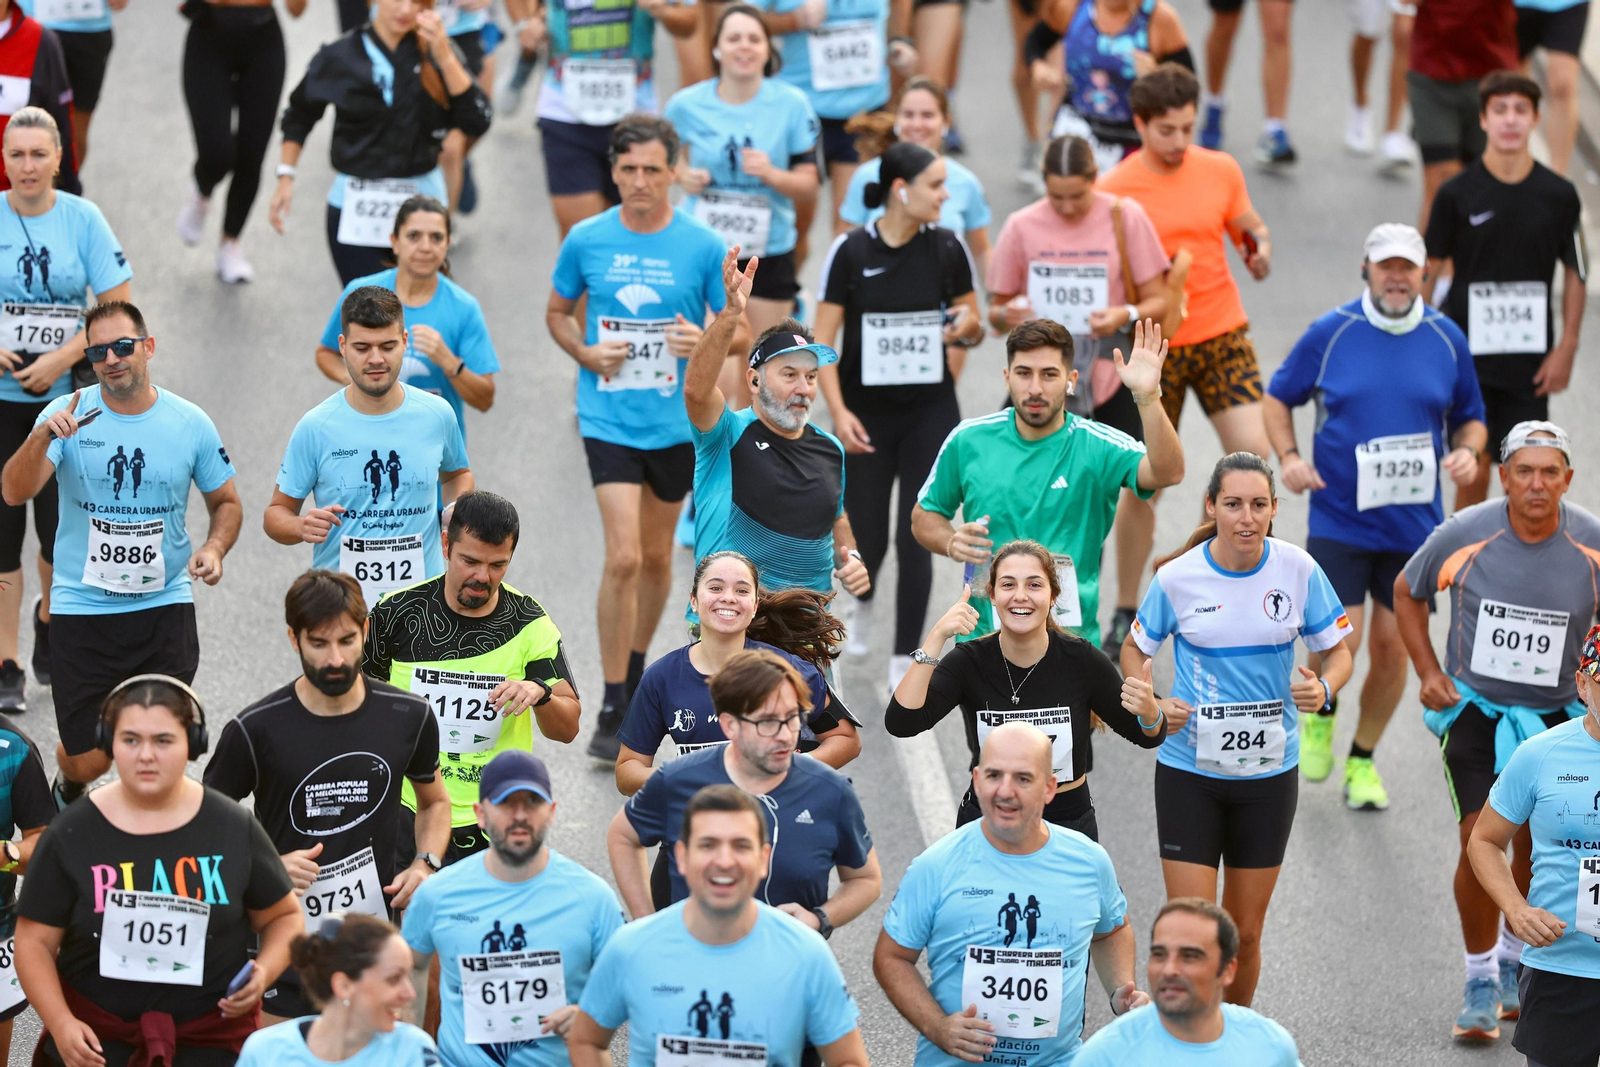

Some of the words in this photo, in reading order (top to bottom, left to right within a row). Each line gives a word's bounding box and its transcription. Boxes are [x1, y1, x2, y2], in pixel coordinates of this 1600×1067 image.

[355, 199, 402, 218] 622
[1044, 286, 1094, 306] 1083
[14, 324, 65, 345] 1769
[878, 334, 930, 356] 9842
[1372, 459, 1424, 479] 1329
[97, 505, 139, 515] CARRERA
[357, 509, 396, 520] CARRERA
[396, 506, 426, 517] URBANA
[91, 518, 111, 536] 43
[111, 523, 142, 531] CARRERA
[143, 520, 164, 530] URBANA
[136, 527, 164, 538] MALAGA
[100, 542, 153, 565] 9886
[343, 538, 365, 553] 43
[391, 541, 422, 552] MALAGA
[355, 559, 412, 582] 6312
[1194, 606, 1217, 614] FLOWER
[1483, 603, 1507, 619] 43
[1491, 627, 1551, 654] 6019
[415, 667, 440, 685] 43
[440, 671, 475, 681] CARRERA
[440, 678, 462, 686] CIUDAD
[980, 712, 1005, 727] 43
[1004, 711, 1039, 720] CARRERA
[1039, 708, 1069, 717] URBANA
[1201, 706, 1225, 720] 43
[1225, 704, 1258, 712] CARRERA
[1259, 701, 1283, 710] URBANA
[1252, 708, 1283, 718] MALAGA
[1220, 729, 1266, 752] 284
[304, 782, 336, 792] CARRERA
[336, 780, 369, 788] POPULAR
[315, 788, 352, 798] MELONERA
[337, 796, 369, 804] MADRID
[1565, 838, 1582, 850] 43
[90, 854, 230, 914] BLACK
[110, 893, 137, 909] 43
[305, 878, 366, 918] 9731
[123, 920, 187, 946] 1051
[462, 957, 489, 972] 43
[970, 947, 996, 965] 43
[996, 950, 1033, 958] CARRERA
[1026, 959, 1062, 967] MALAGA
[481, 978, 549, 1005] 6179
[981, 975, 1048, 1002] 3406
[662, 1038, 689, 1055] 43
[982, 1054, 1028, 1067] Unicaja
